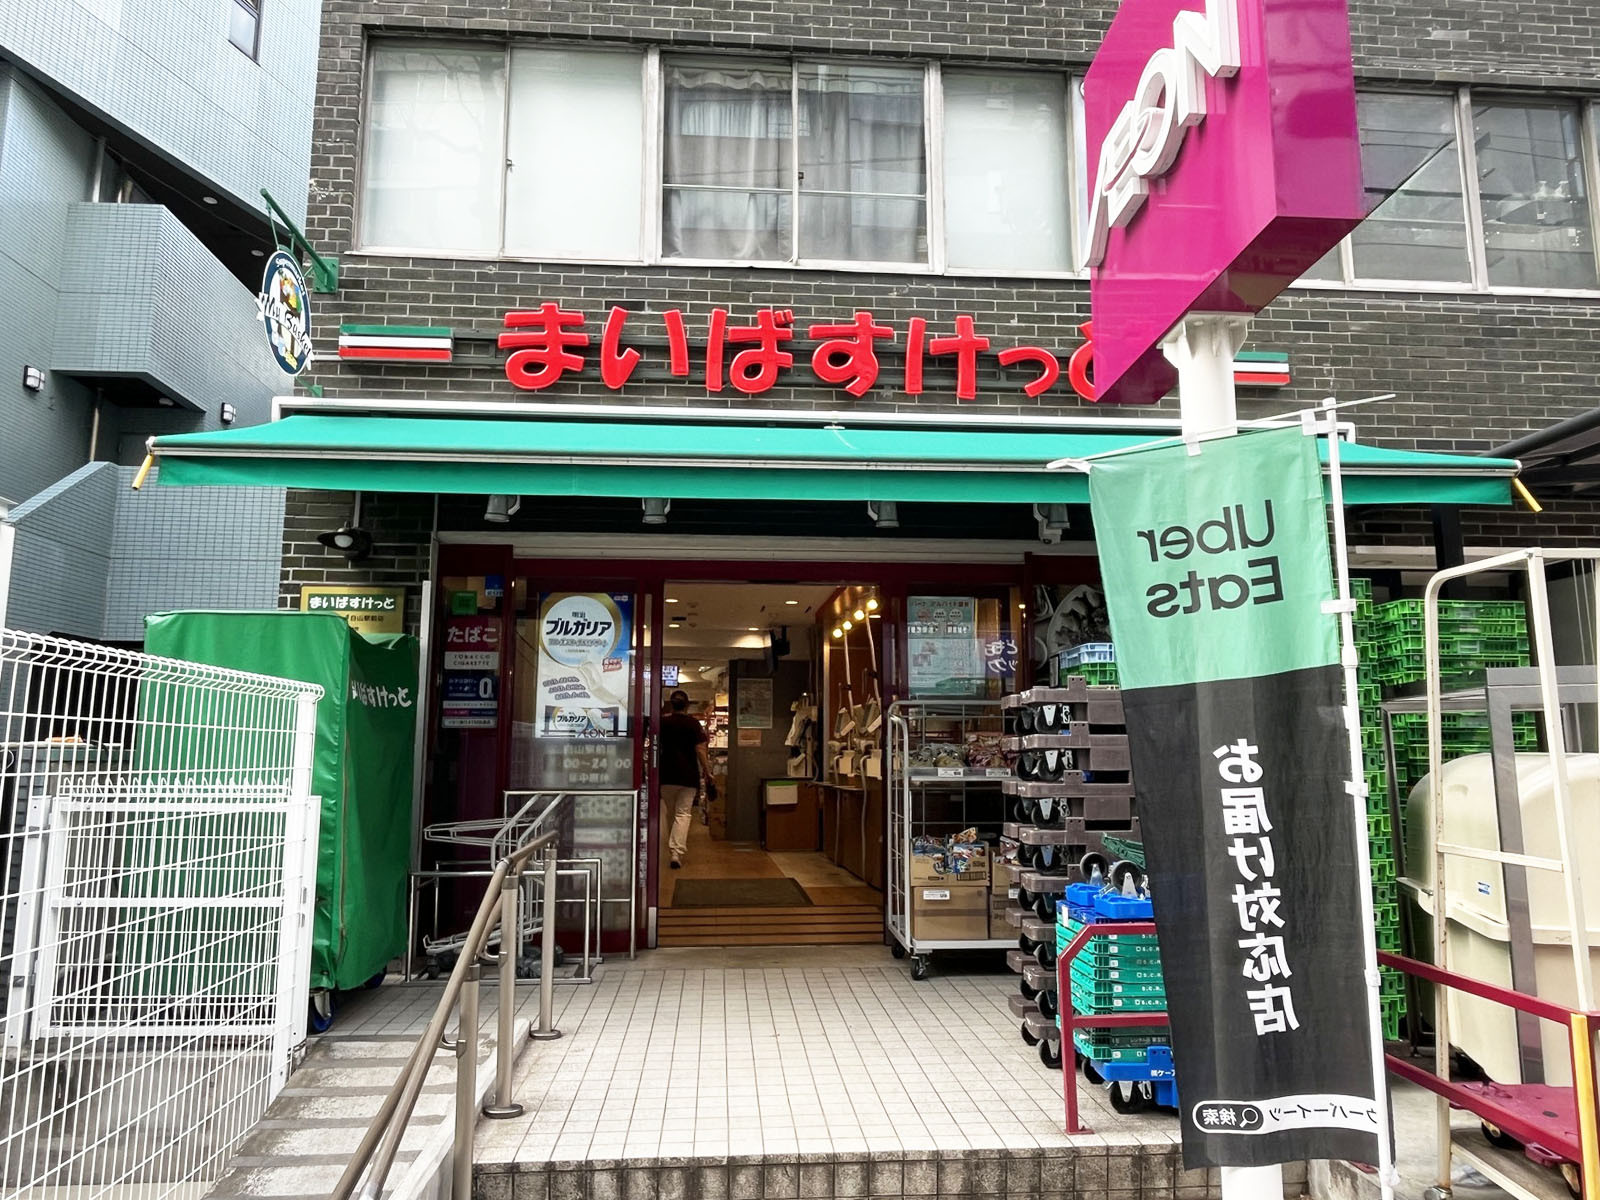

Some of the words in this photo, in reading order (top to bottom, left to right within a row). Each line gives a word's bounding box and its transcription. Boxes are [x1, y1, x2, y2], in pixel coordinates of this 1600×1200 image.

[309, 596, 395, 610] まいばすけっと
[447, 626, 498, 643] たばこ
[546, 618, 612, 637] ブルガリア
